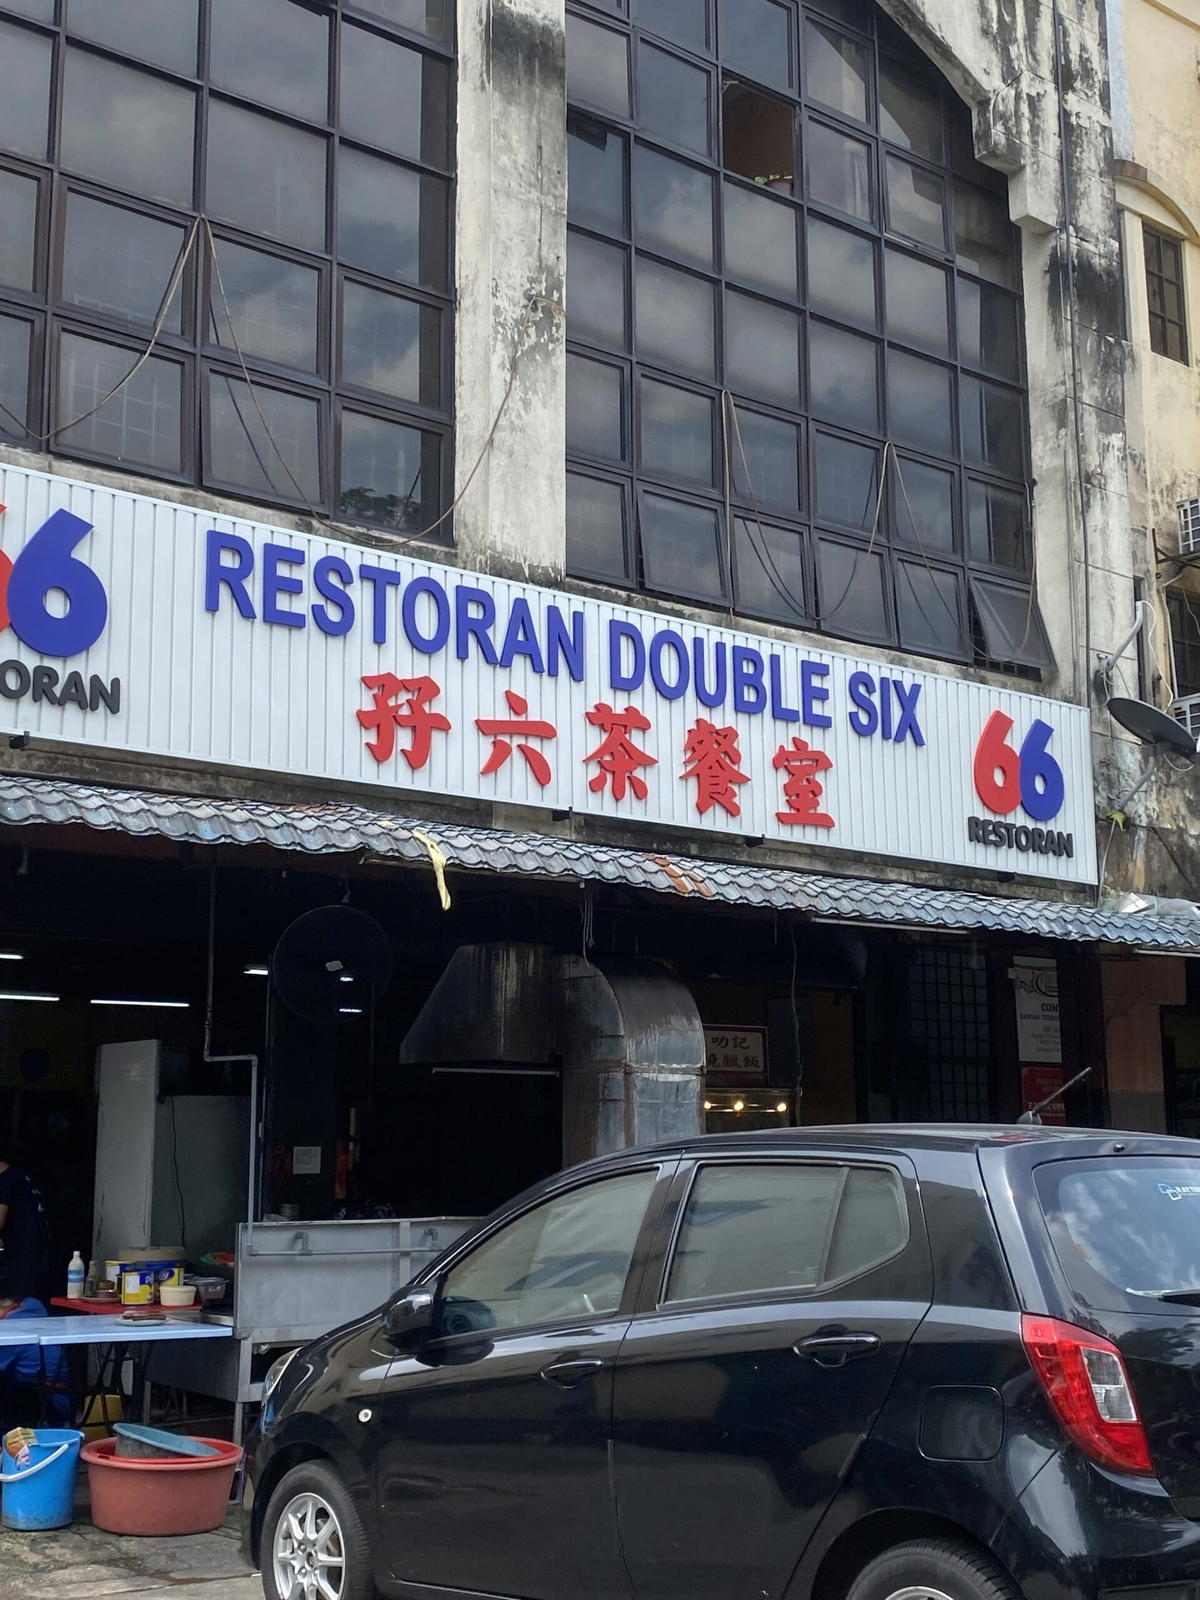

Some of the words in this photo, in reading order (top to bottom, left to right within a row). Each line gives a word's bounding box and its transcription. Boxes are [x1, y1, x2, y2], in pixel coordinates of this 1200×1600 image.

[0, 504, 107, 657] 6
[205, 529, 584, 682] RESTORAN
[609, 618, 832, 729] DOUBLE
[848, 670, 926, 747] SIX
[356, 671, 836, 830] 孖六茶餐室
[973, 709, 1065, 821] 66
[967, 815, 1074, 858] RESTORAN
